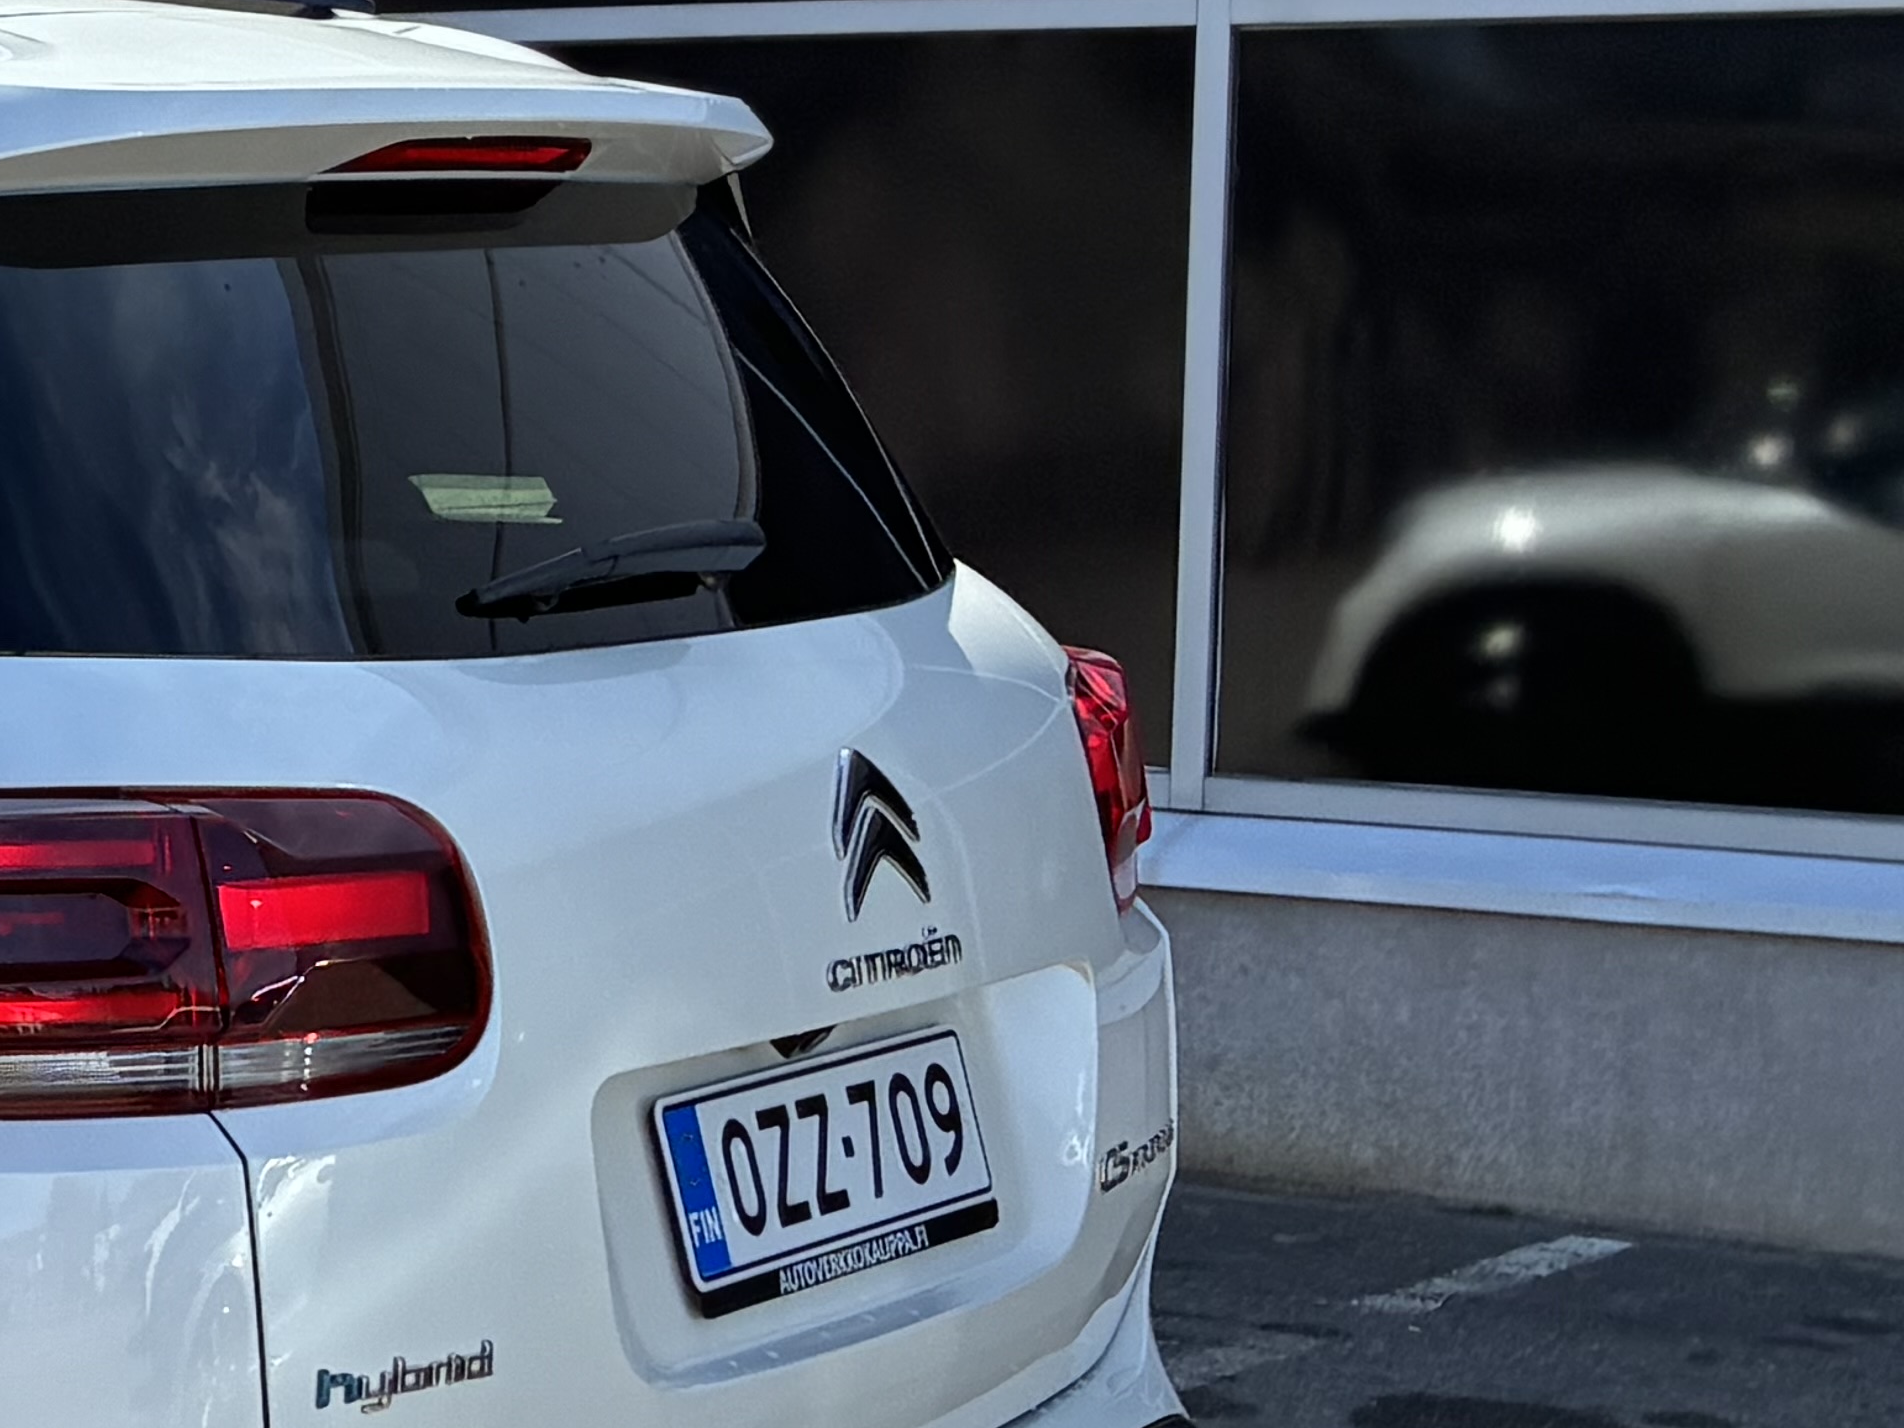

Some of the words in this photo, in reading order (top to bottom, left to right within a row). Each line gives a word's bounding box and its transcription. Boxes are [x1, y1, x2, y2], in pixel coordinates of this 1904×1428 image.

[826, 925, 963, 992] CITROËN
[721, 1062, 963, 1237] OZZ-709
[688, 1206, 723, 1248] FIN
[315, 1339, 494, 1414] hybrid
